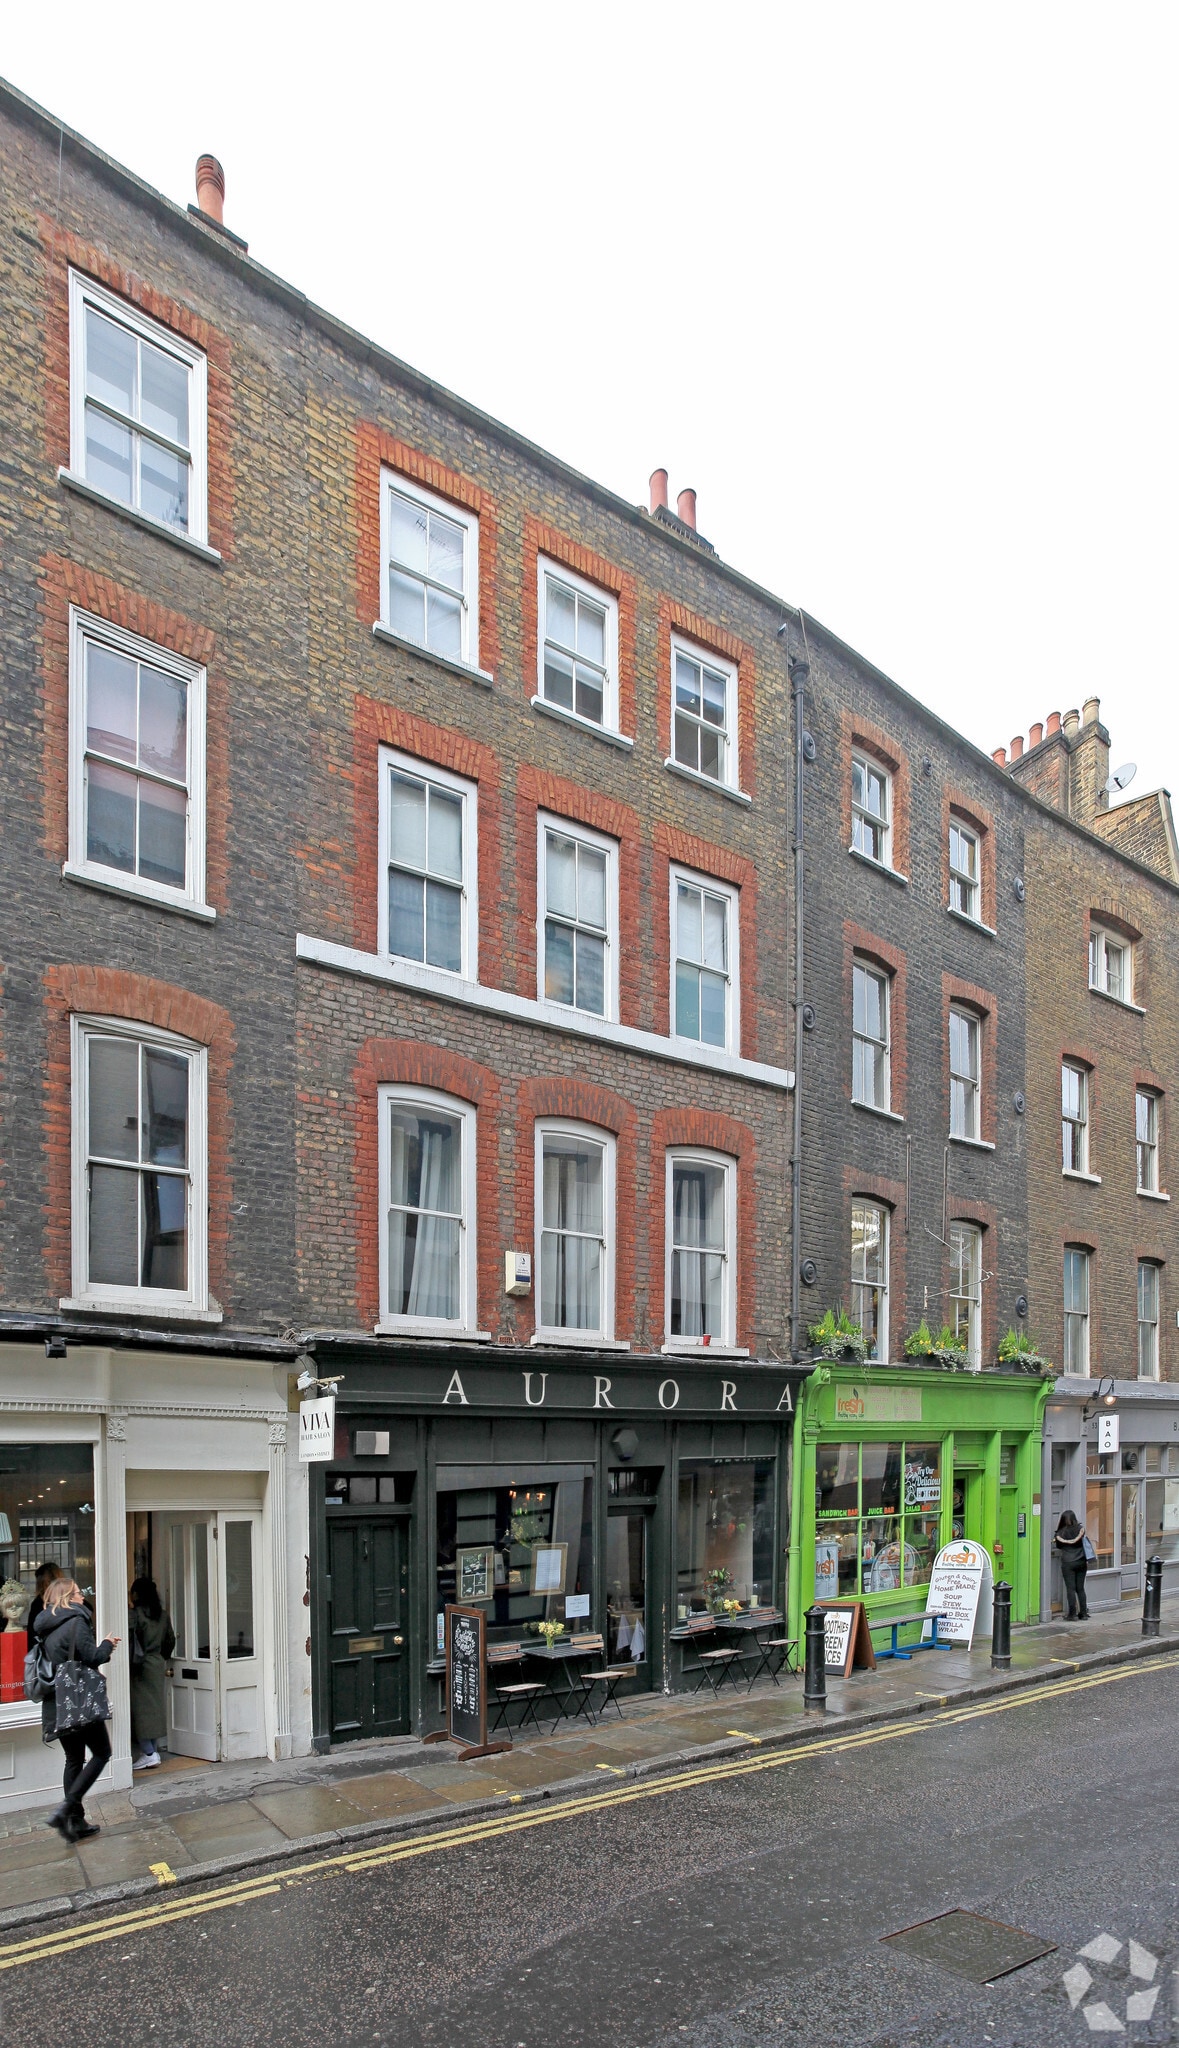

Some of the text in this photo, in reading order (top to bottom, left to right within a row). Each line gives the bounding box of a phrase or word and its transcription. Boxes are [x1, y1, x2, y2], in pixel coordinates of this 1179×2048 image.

[442, 1369, 794, 1412] AURORA
[302, 1411, 330, 1431] VIVA
[1173, 1421, 1179, 1431] B
[314, 1431, 331, 1439] SALON
[1104, 1420, 1112, 1448] BAO
[917, 1466, 934, 1477] Try Our
[927, 1489, 940, 1497] FOOD
[818, 1508, 858, 1517] SANDWICH BAR
[867, 1506, 894, 1515] JUICE BAR
[942, 1552, 977, 1564] fresh
[934, 1574, 955, 1583] Gluten
[962, 1574, 978, 1584] Dairy
[824, 1620, 849, 1634] OOTHIES
[824, 1635, 844, 1650] REEN
[825, 1650, 842, 1664] ICES
